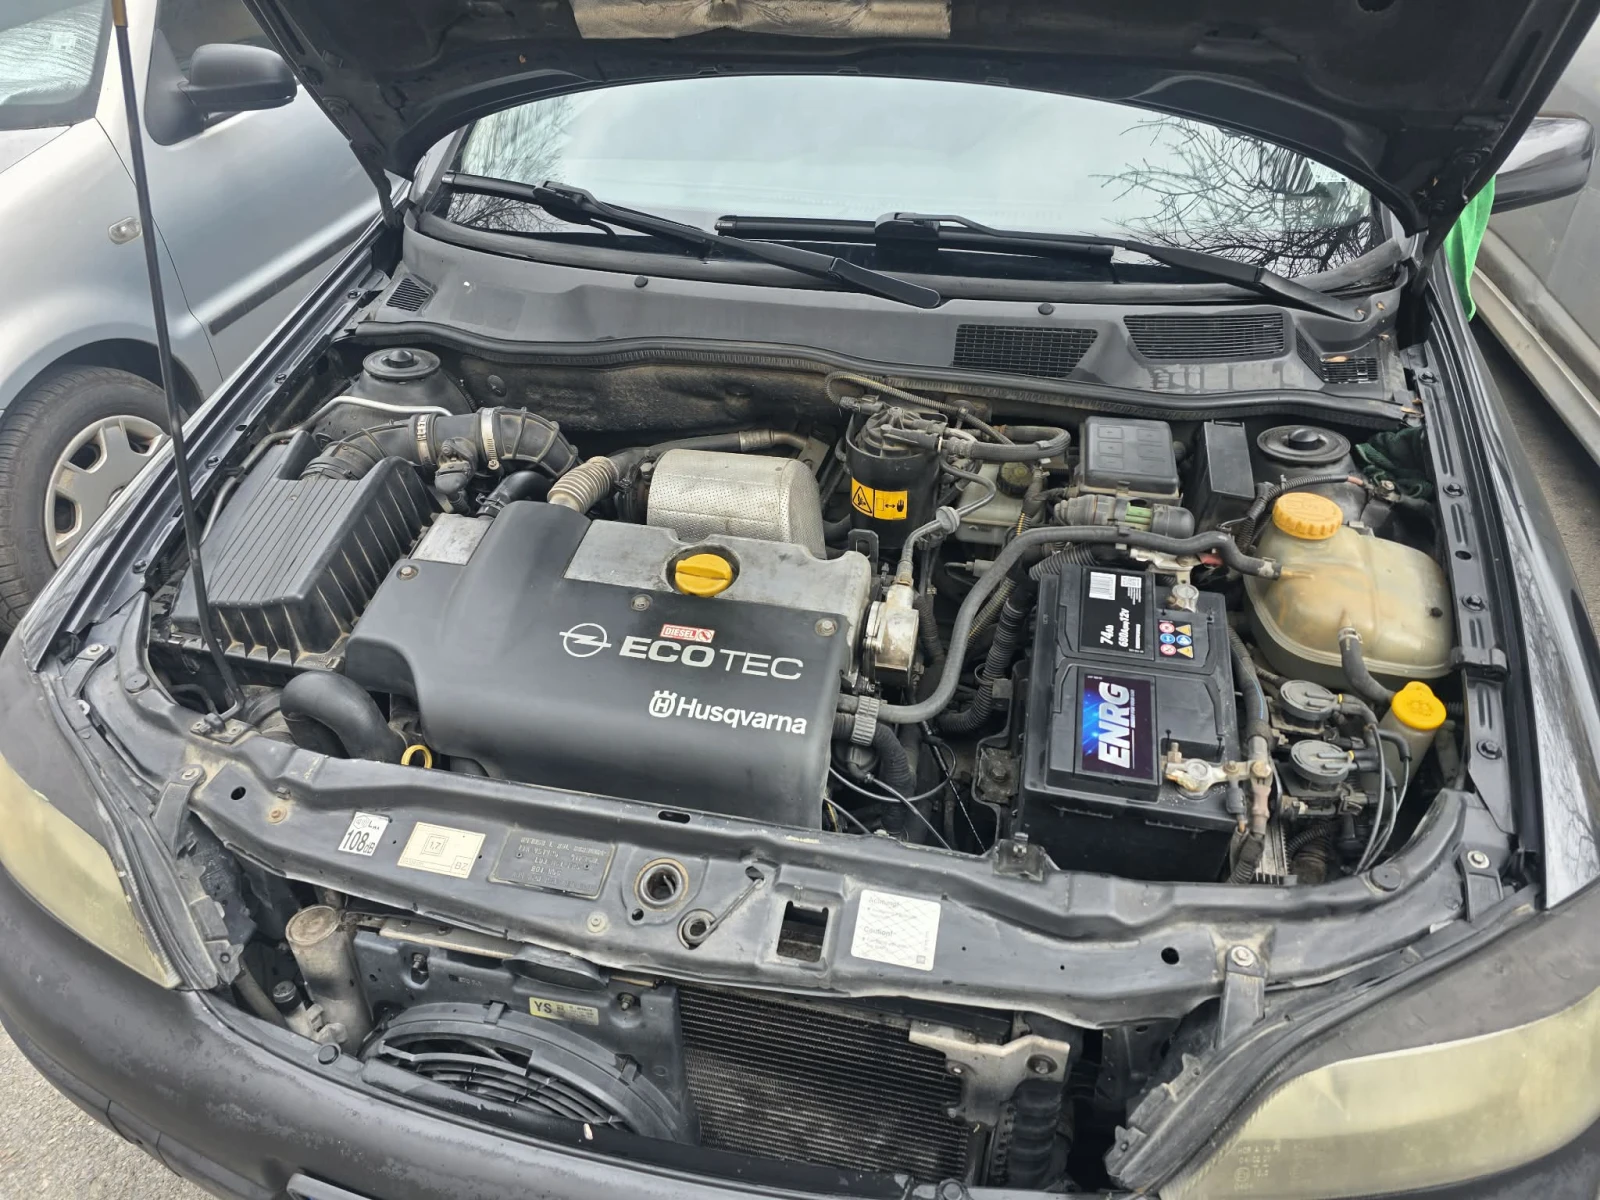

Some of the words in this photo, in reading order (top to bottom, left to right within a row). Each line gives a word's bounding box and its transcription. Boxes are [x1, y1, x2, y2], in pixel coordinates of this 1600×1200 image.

[664, 627, 696, 639] DIESEL
[676, 697, 808, 735] Husqvarna
[1098, 682, 1131, 769] ENRG
[534, 1001, 552, 1014] YS
